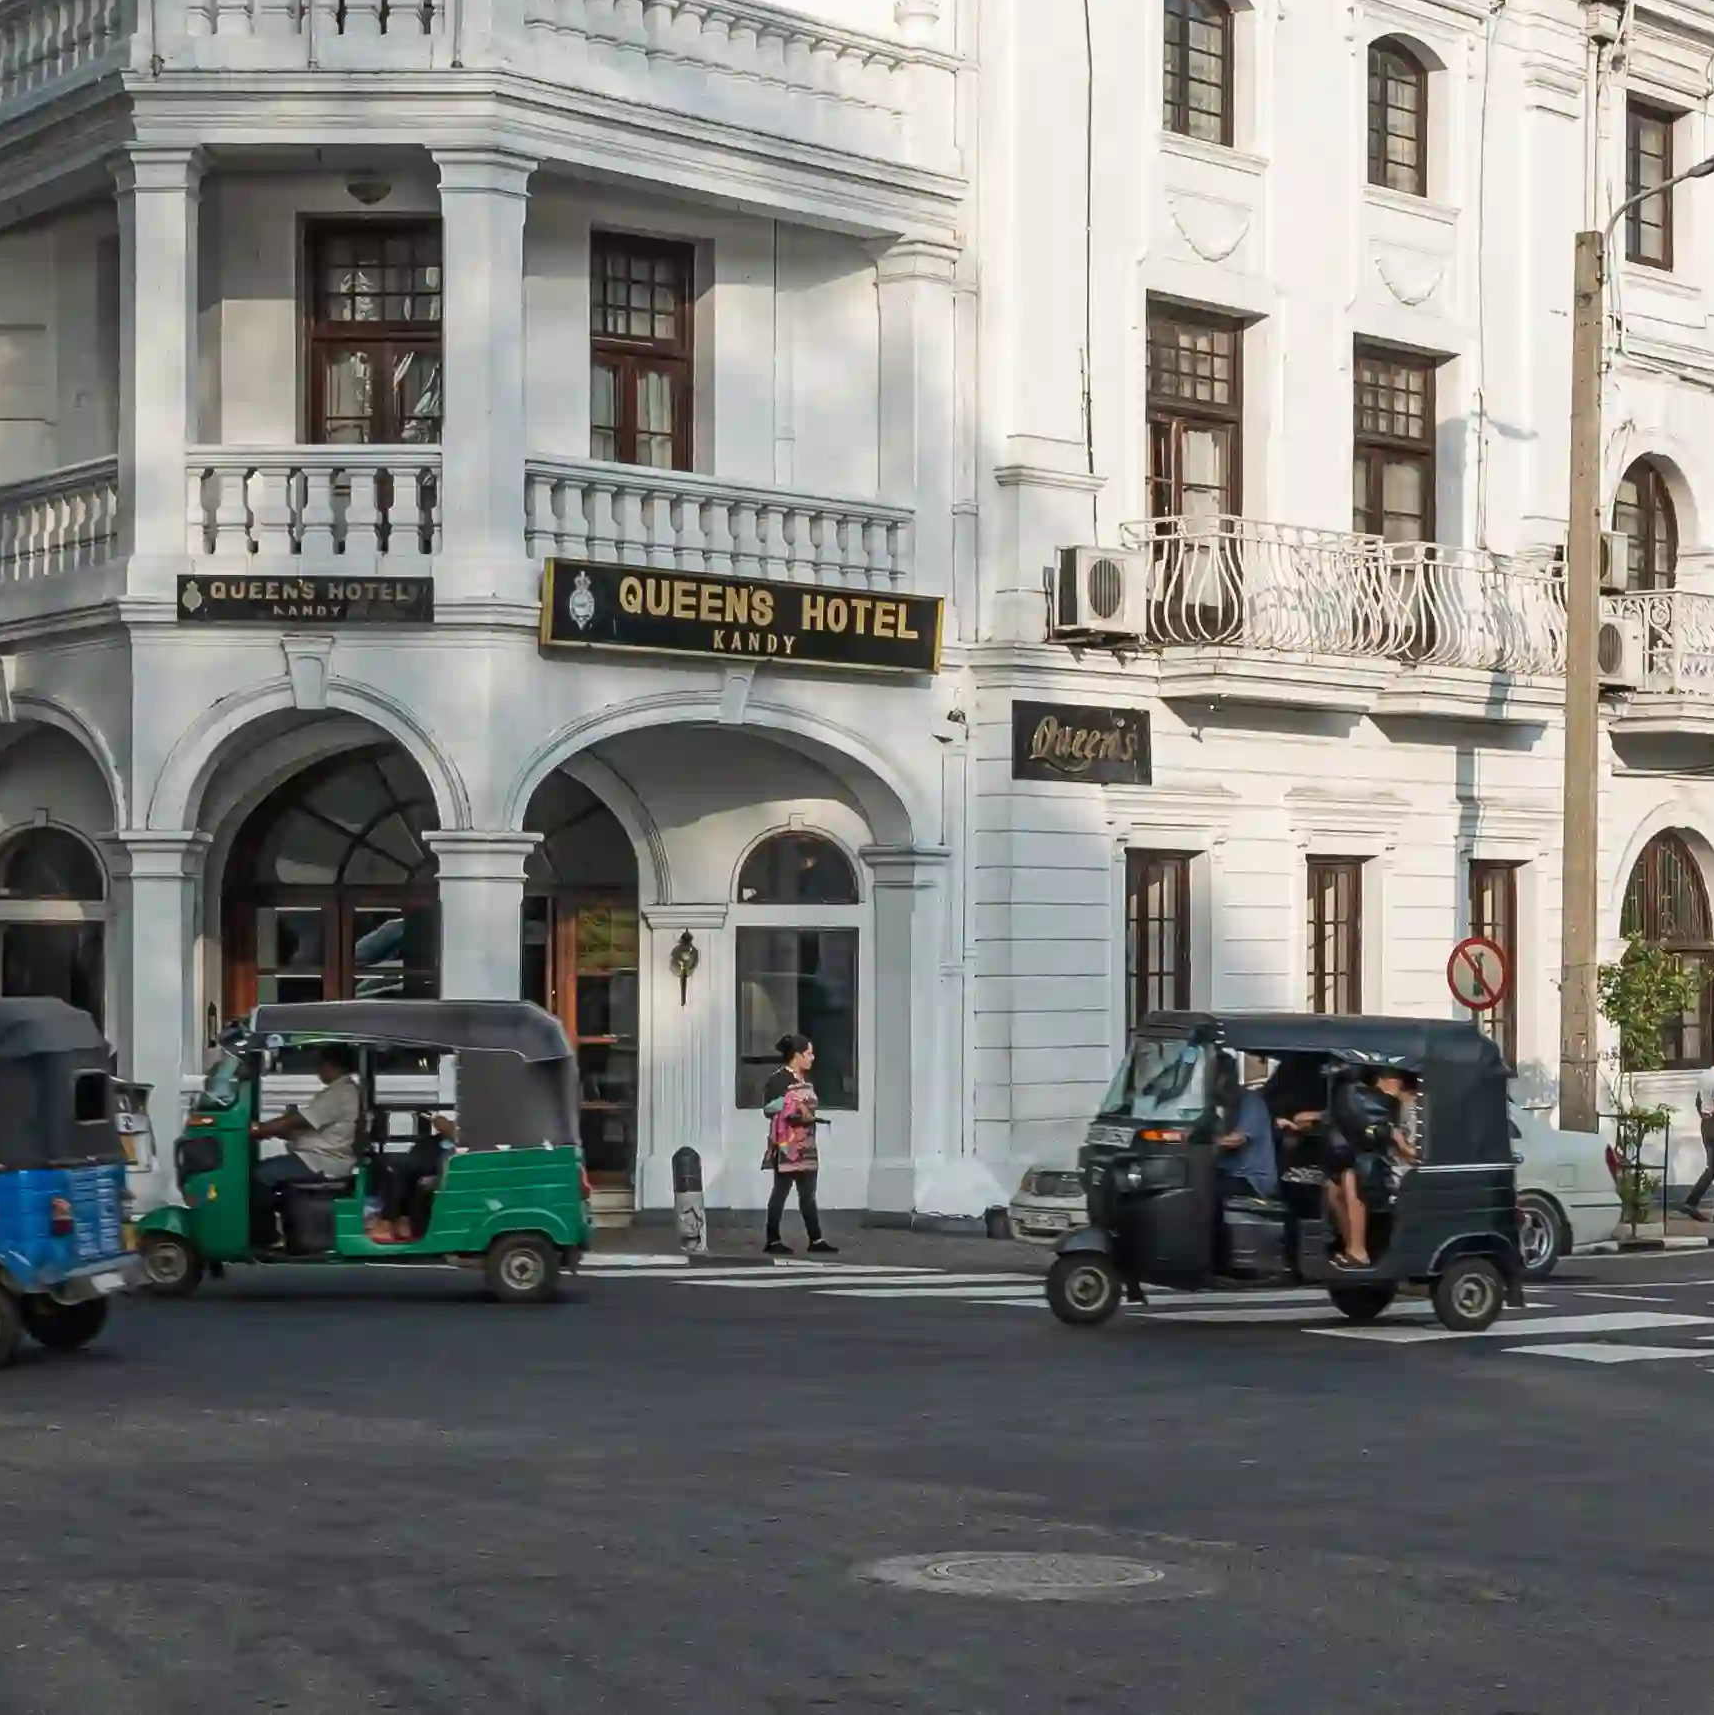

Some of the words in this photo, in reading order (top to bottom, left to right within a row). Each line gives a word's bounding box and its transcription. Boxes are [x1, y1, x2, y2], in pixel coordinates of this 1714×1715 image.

[209, 578, 316, 601] QUEEN'S
[328, 582, 410, 602] HOTEL
[618, 575, 775, 627] QUEEN'S
[800, 593, 920, 640] HOTEL
[712, 628, 798, 656] KANDY
